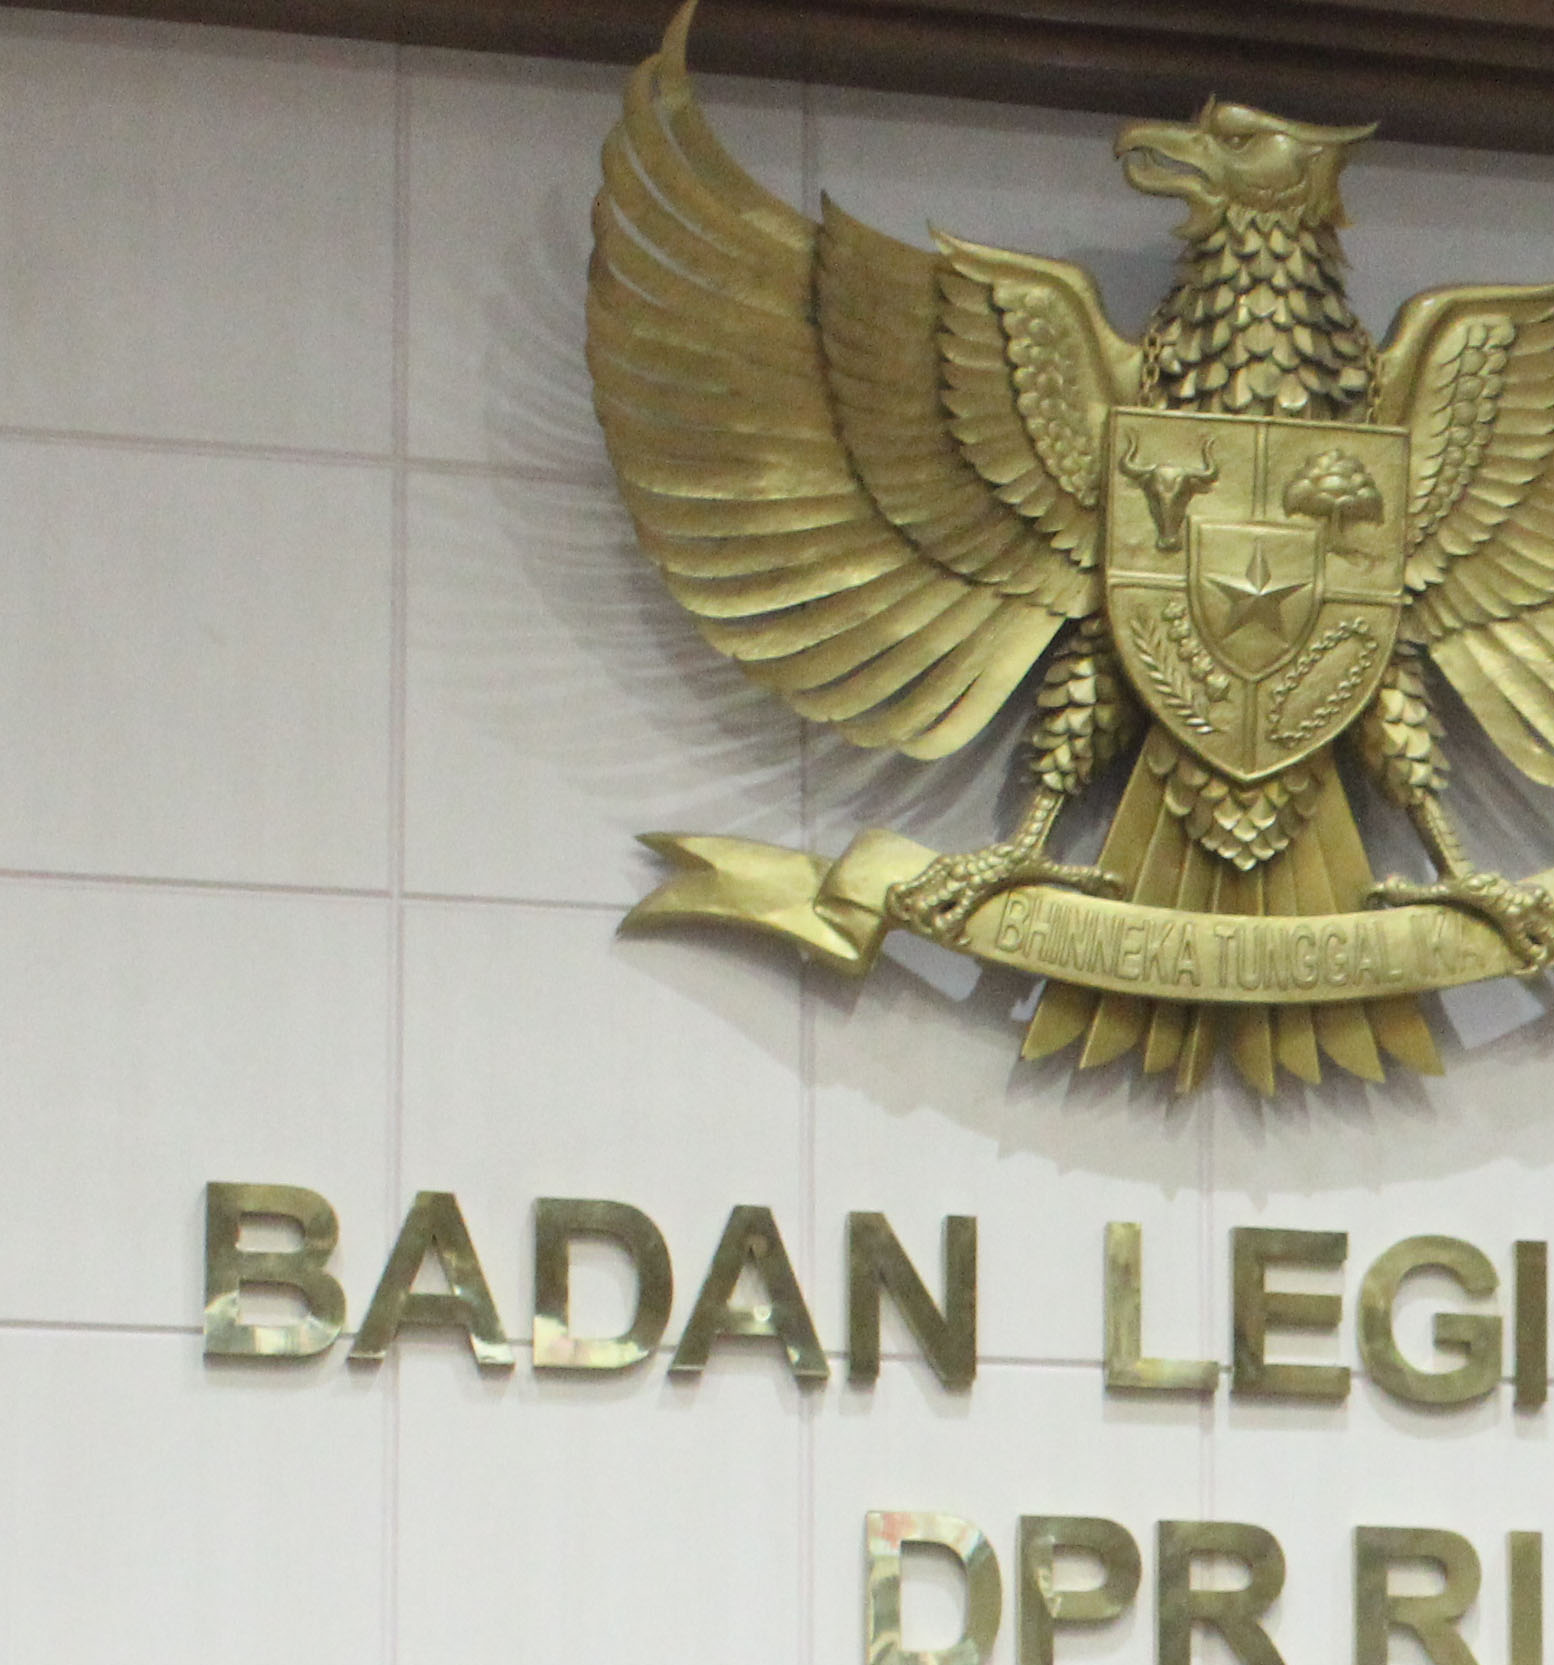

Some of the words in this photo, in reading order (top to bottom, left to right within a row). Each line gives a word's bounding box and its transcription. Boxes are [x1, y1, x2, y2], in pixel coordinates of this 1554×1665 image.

[996, 893, 1200, 987] BHINNEKA
[1214, 920, 1401, 991] TUNGGAL
[203, 1181, 978, 1386] BADAN
